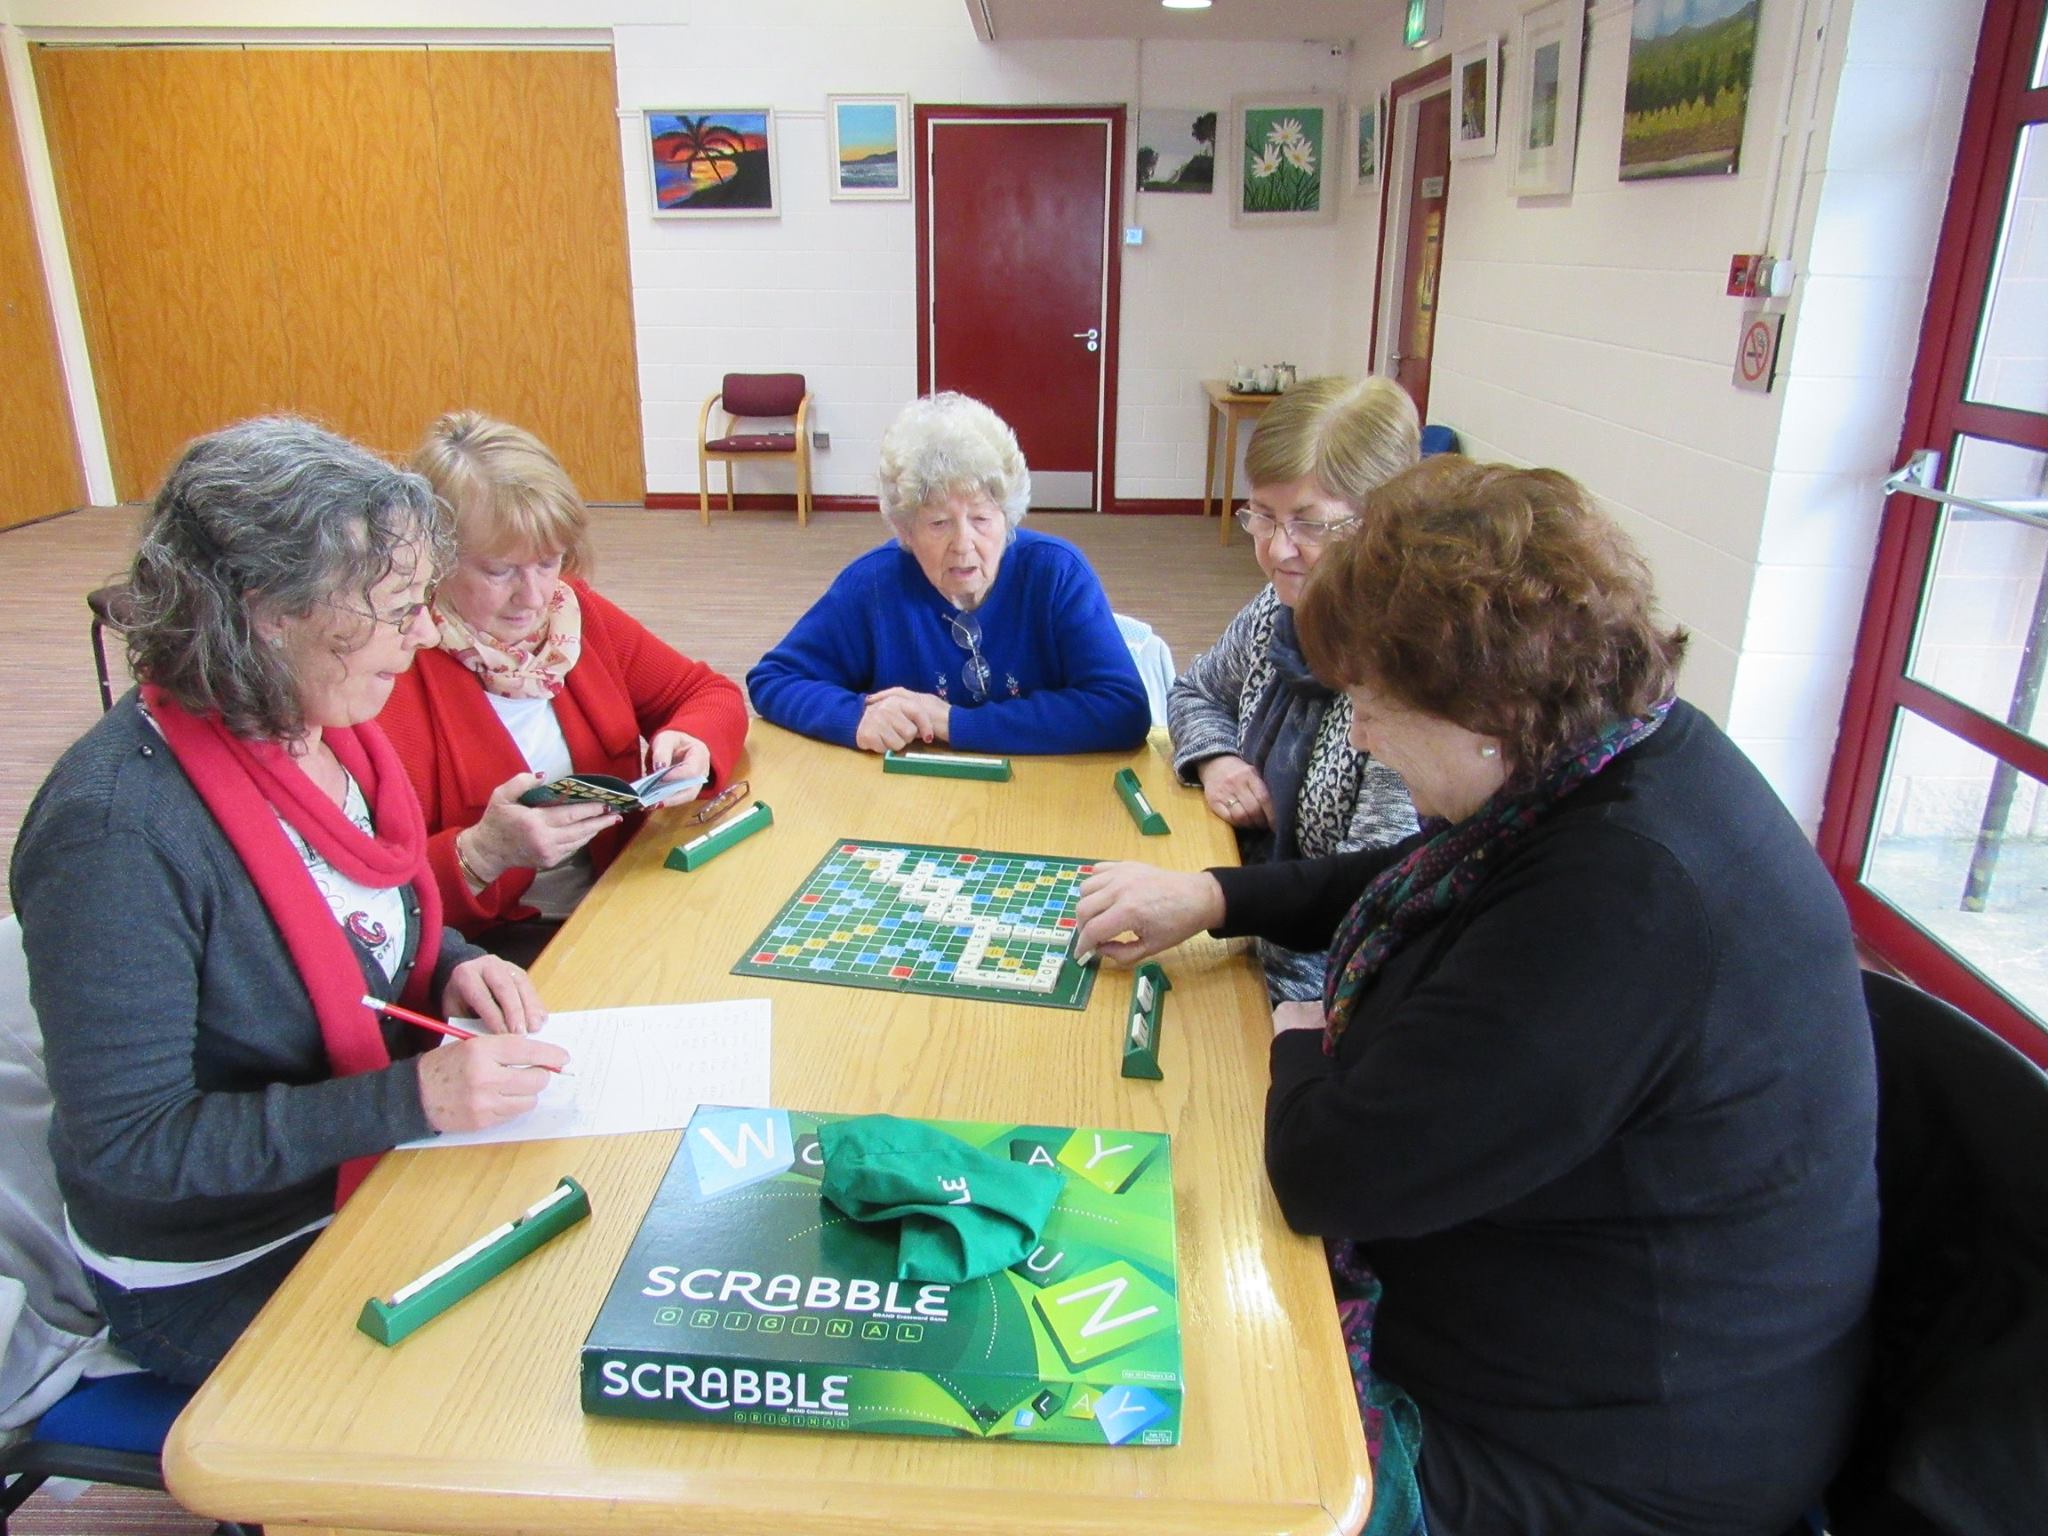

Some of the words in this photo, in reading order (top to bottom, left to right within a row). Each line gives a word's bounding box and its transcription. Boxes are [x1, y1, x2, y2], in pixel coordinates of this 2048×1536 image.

[642, 1265, 951, 1317] SCRABBLE
[659, 1310, 918, 1340] ORIGINAL
[601, 1360, 849, 1411] SCRABBLE
[735, 1412, 849, 1428] ORIGINAL
